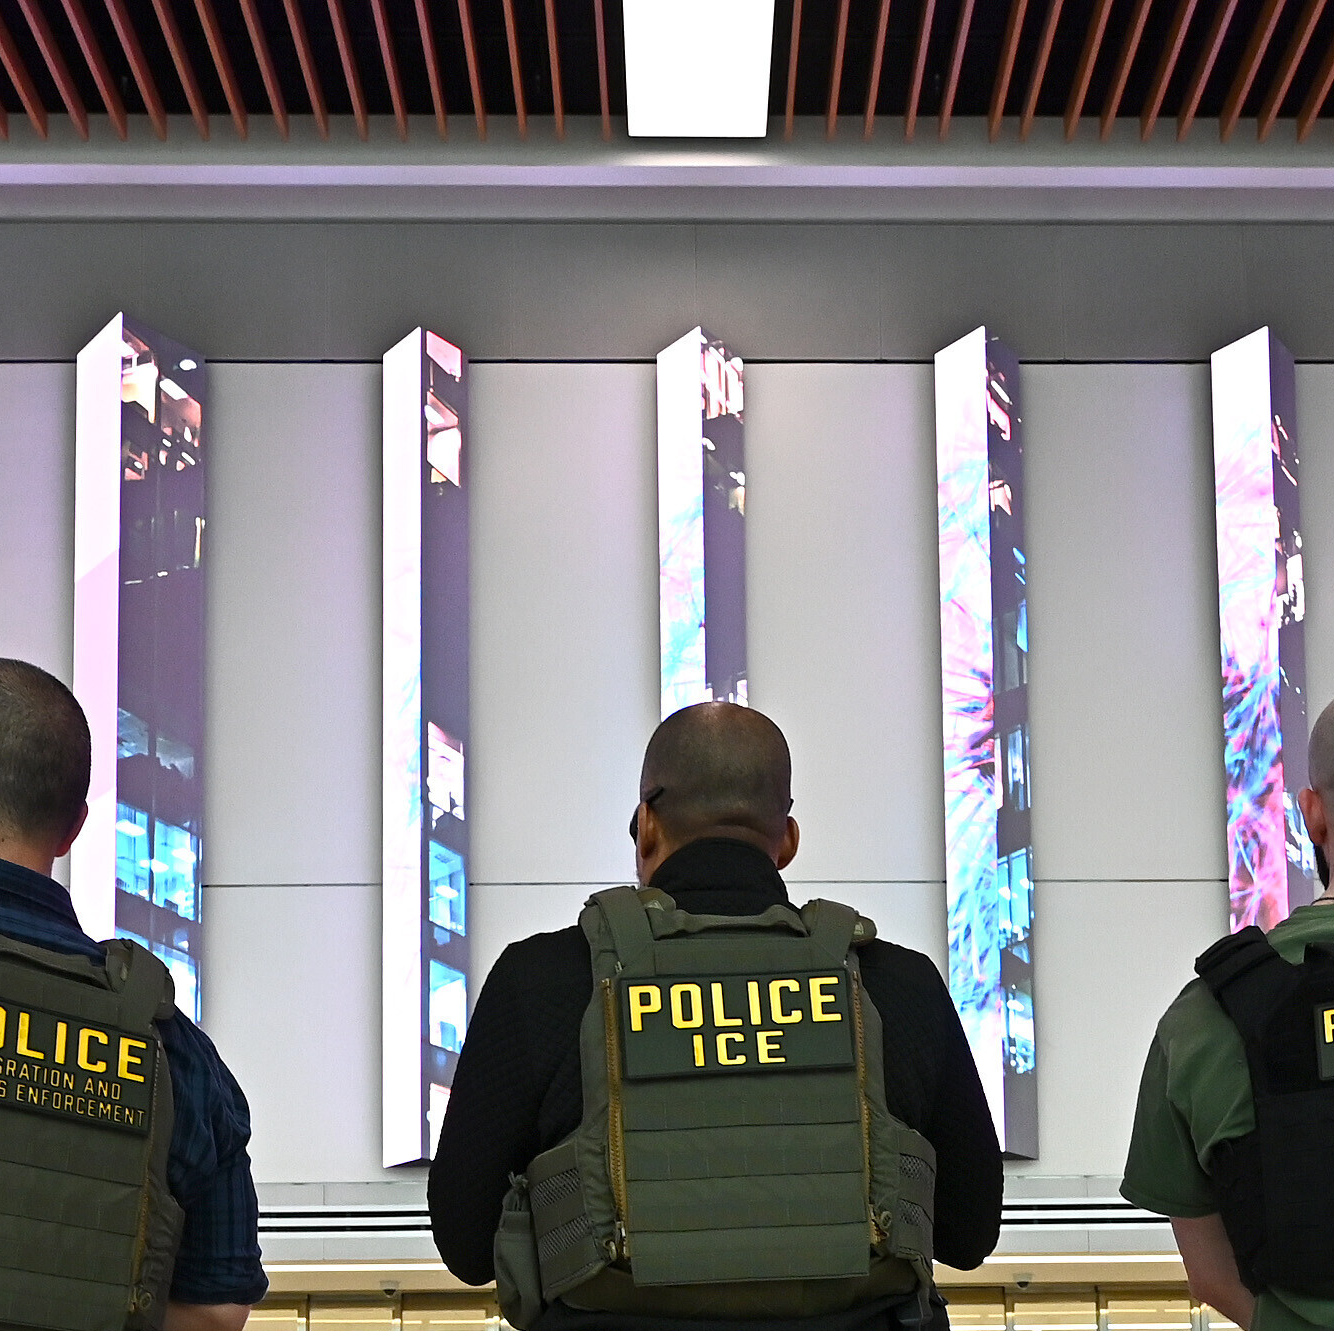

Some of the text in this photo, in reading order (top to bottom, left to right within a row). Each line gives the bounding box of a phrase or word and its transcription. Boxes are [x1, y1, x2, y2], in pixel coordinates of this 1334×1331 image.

[628, 976, 842, 1032] POLICE
[692, 1030, 786, 1067] ICE
[16, 1084, 145, 1127] ENFORCEMENT
[83, 1076, 121, 1101] AND
